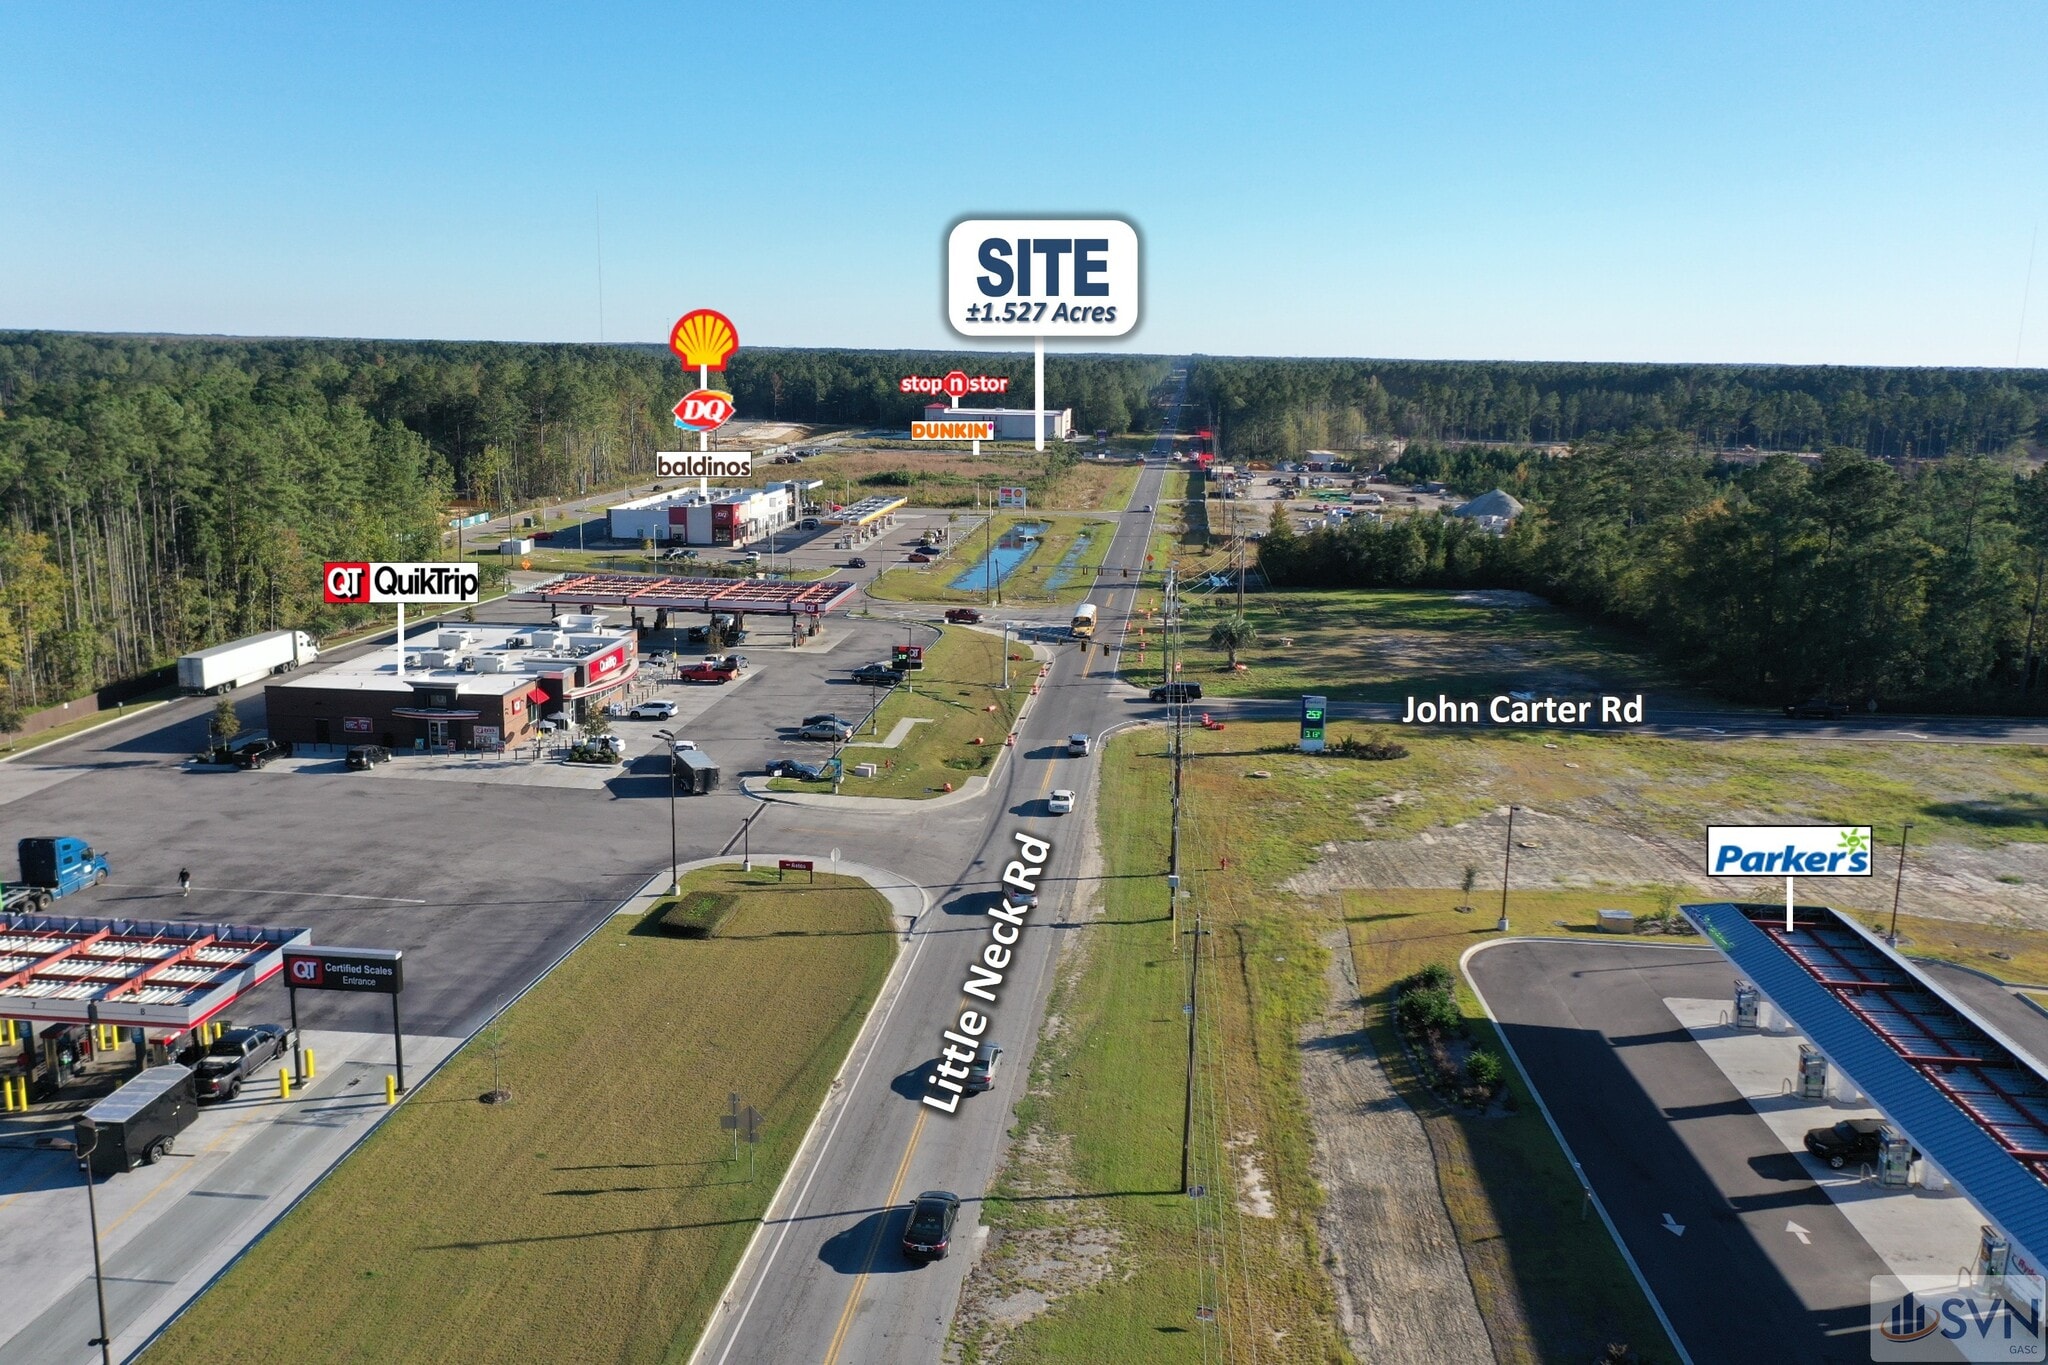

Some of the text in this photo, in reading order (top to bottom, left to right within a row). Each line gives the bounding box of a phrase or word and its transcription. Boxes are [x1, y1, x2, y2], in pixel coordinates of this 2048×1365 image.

[293, 961, 393, 980] QT Certified Scales
[343, 976, 376, 986] Entrance
